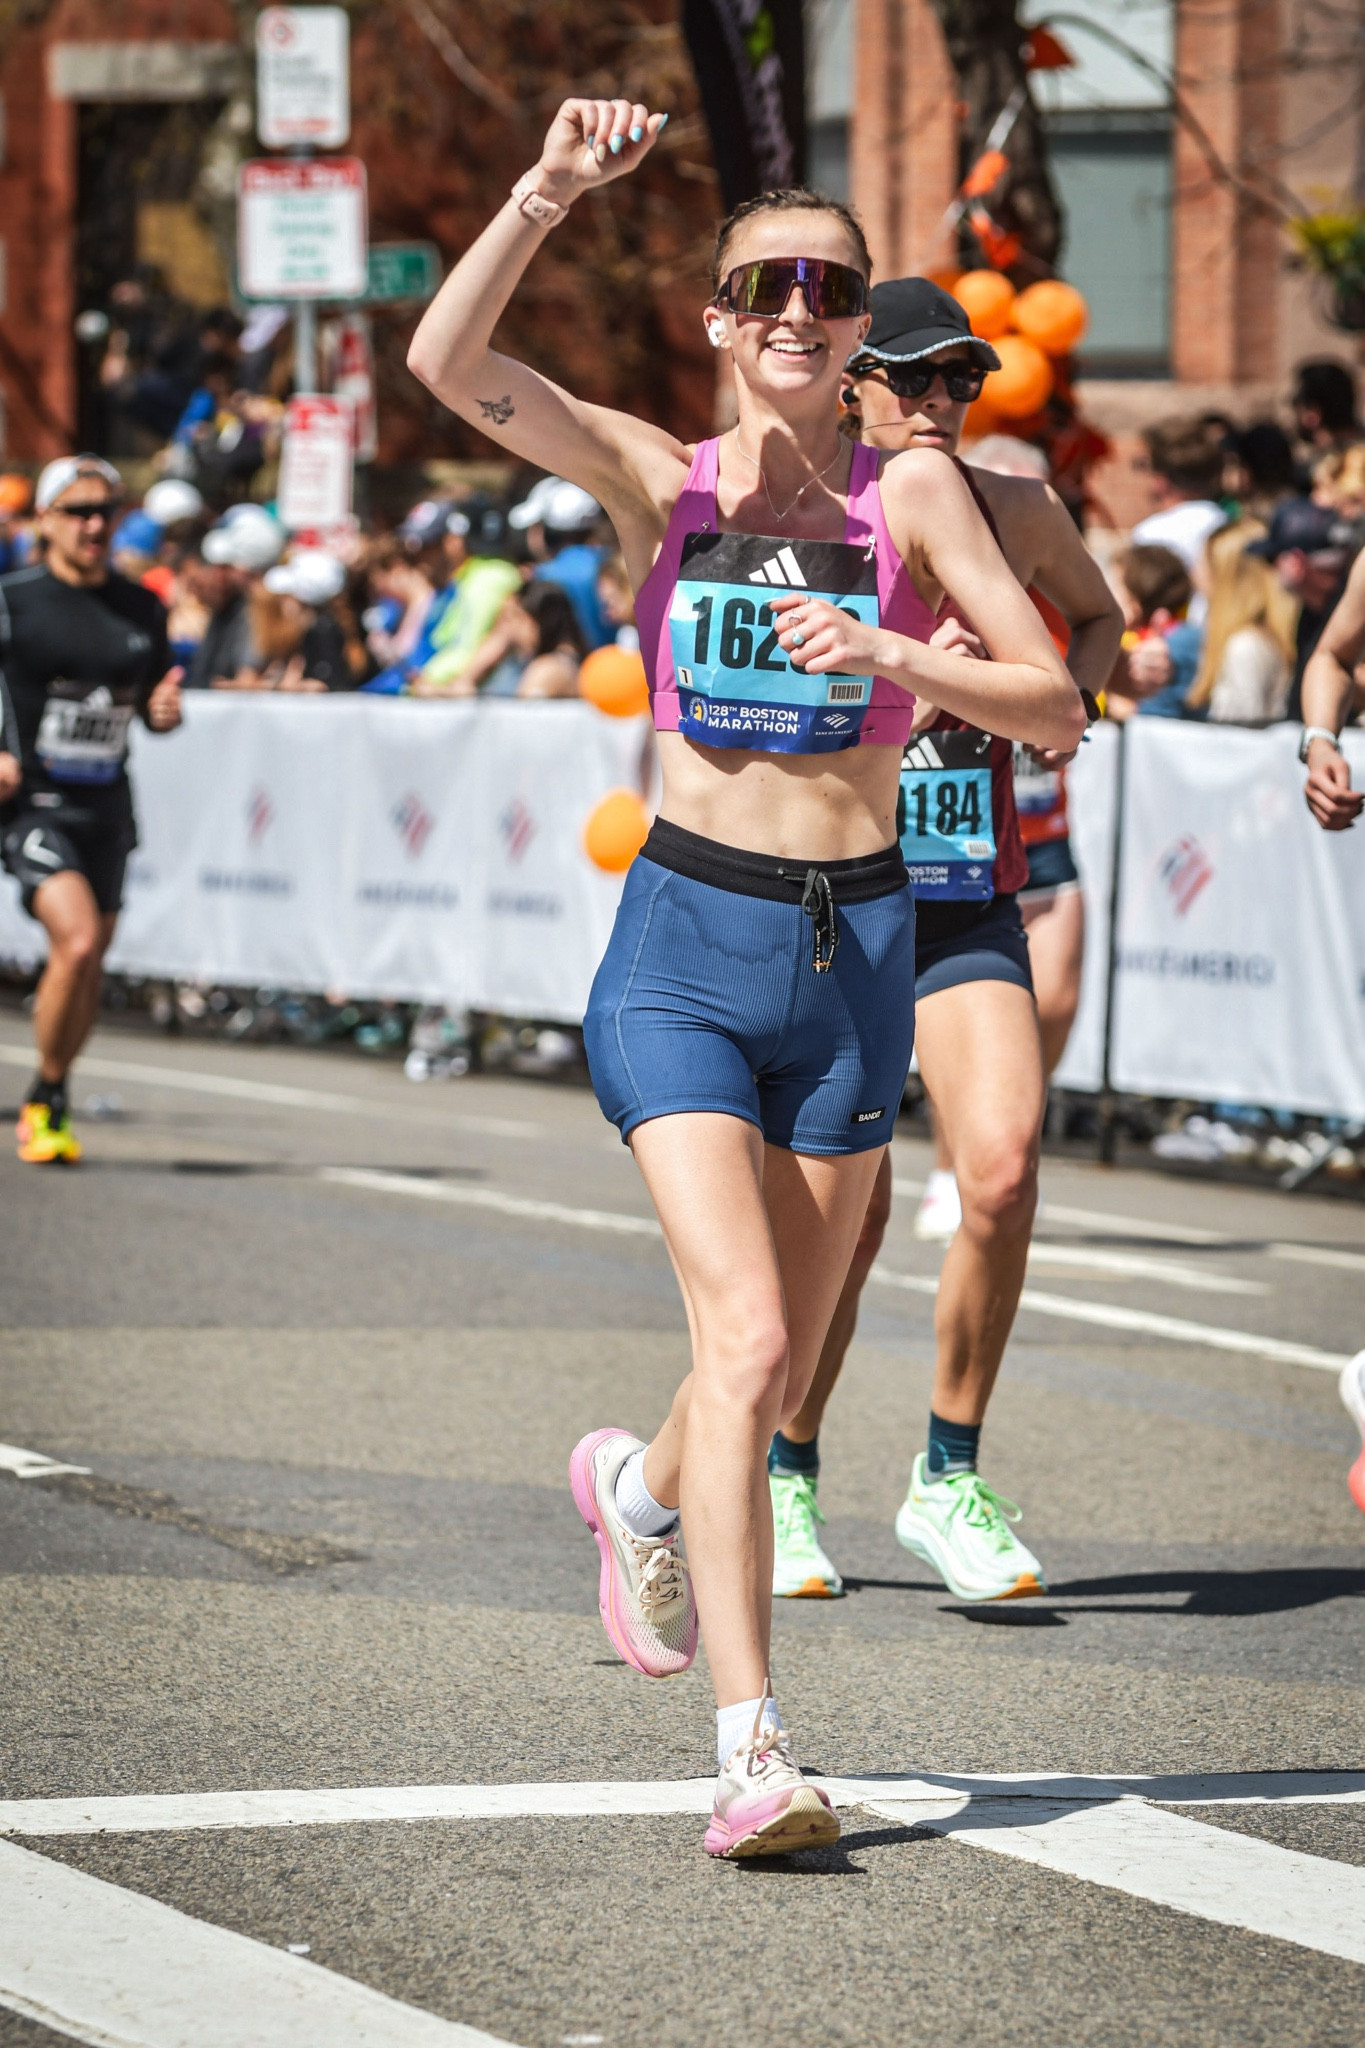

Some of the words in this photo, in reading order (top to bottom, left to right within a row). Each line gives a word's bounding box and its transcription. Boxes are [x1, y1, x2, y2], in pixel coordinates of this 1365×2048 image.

[692, 595, 861, 677] 162
[708, 704, 738, 716] 128TH
[741, 707, 798, 722] BOSTON
[708, 718, 798, 734] MARATHON
[907, 866, 948, 875] OSTON
[858, 1110, 882, 1122] BANDIT
